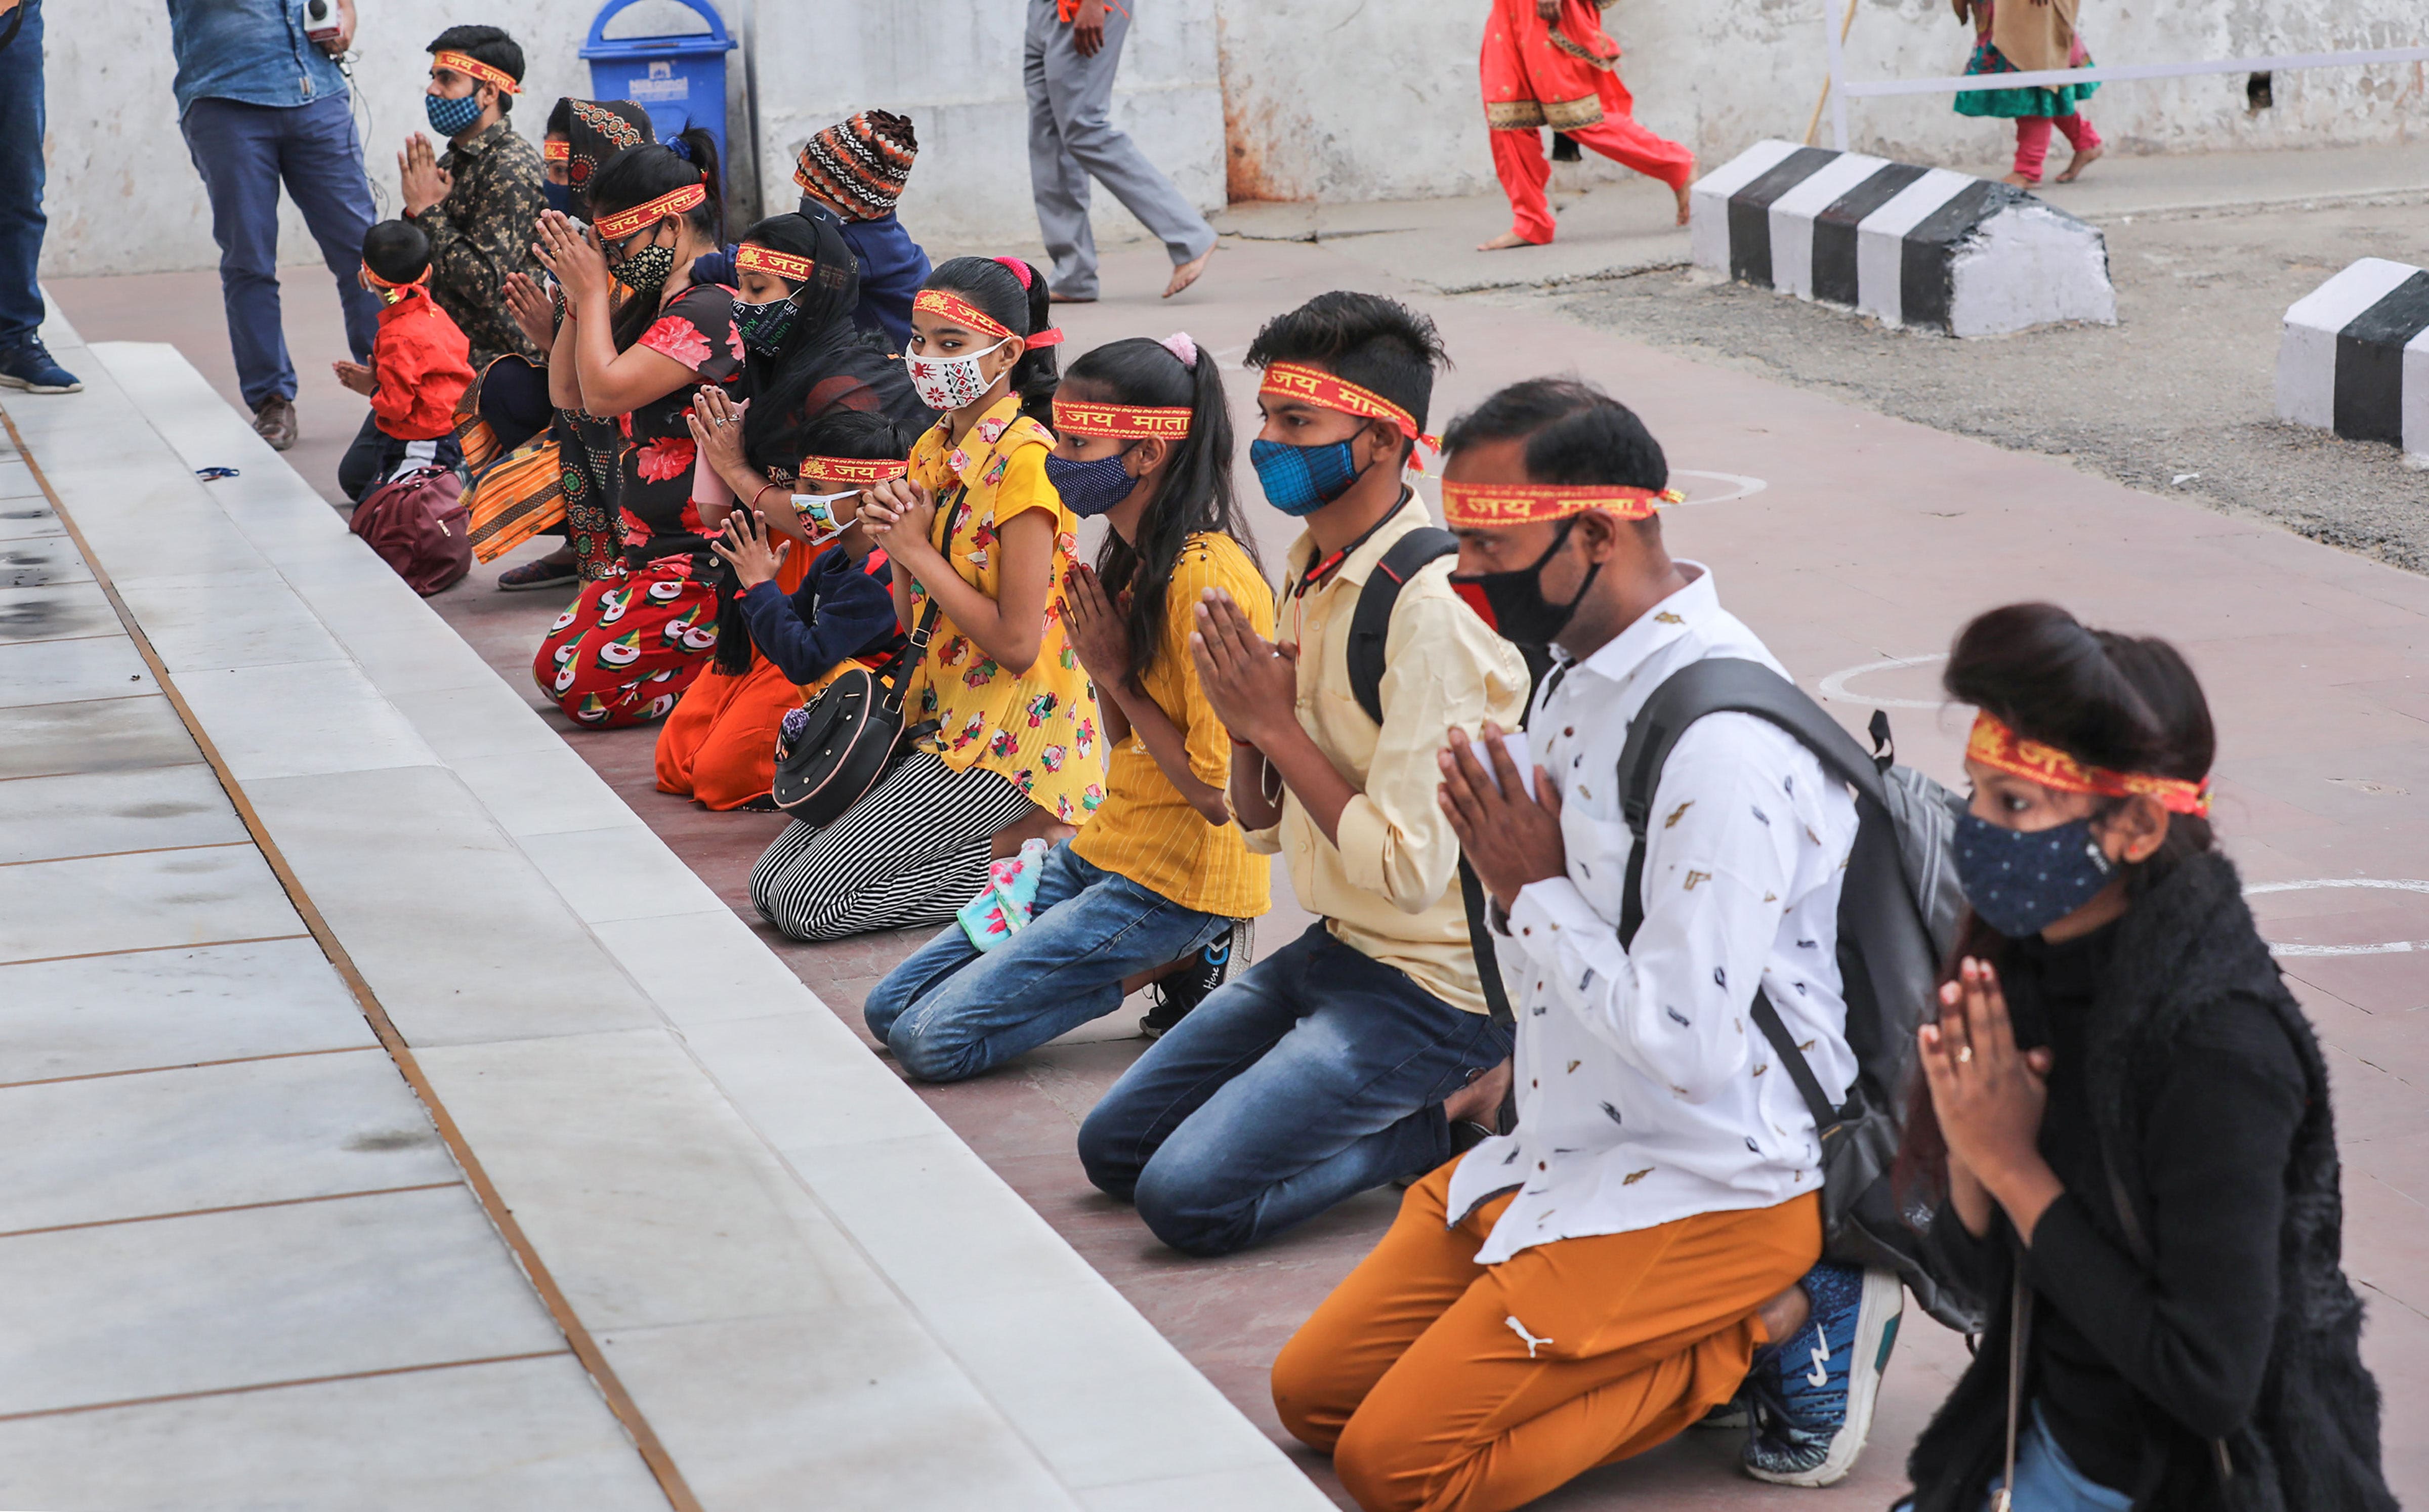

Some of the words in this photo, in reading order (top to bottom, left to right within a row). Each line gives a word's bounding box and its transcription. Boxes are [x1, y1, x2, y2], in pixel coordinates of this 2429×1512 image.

[445, 56, 474, 70] जय
[605, 214, 640, 230] जय
[649, 193, 691, 215] माता
[767, 256, 809, 274] जय
[957, 303, 997, 329] जय
[1271, 370, 1322, 394] जय
[1065, 410, 1116, 428] जय
[1132, 415, 1191, 430] माता
[834, 465, 877, 478] जय
[1468, 497, 1536, 517] जय
